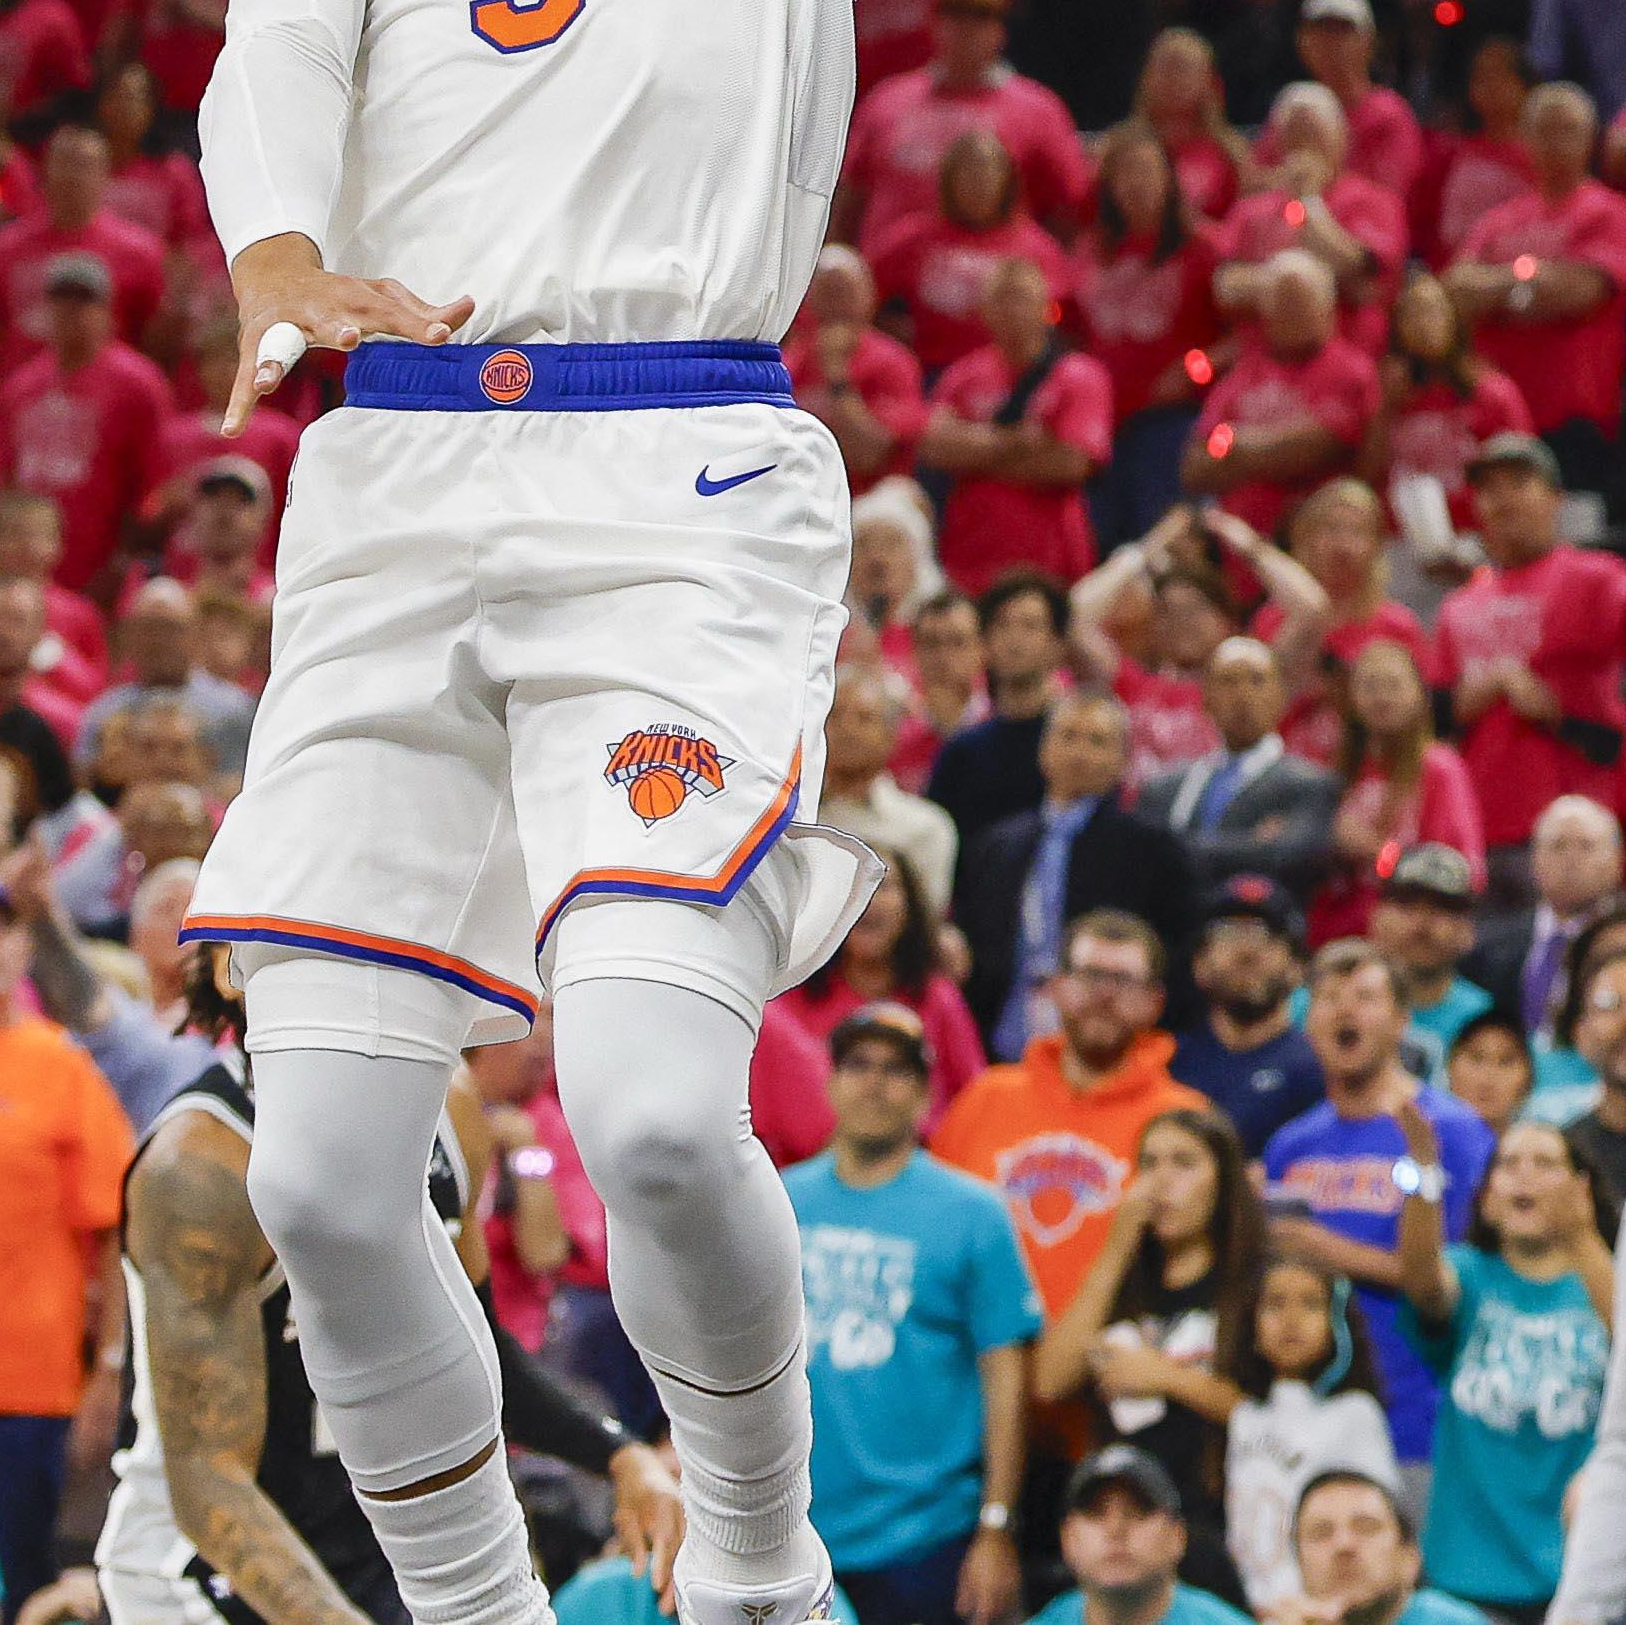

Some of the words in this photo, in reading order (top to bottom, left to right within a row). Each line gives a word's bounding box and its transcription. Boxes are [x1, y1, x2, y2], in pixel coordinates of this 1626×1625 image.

[485, 364, 525, 389] KNICKS
[646, 723, 670, 734] NEW
[671, 723, 697, 739] YORK
[604, 730, 724, 791] KNICKS
